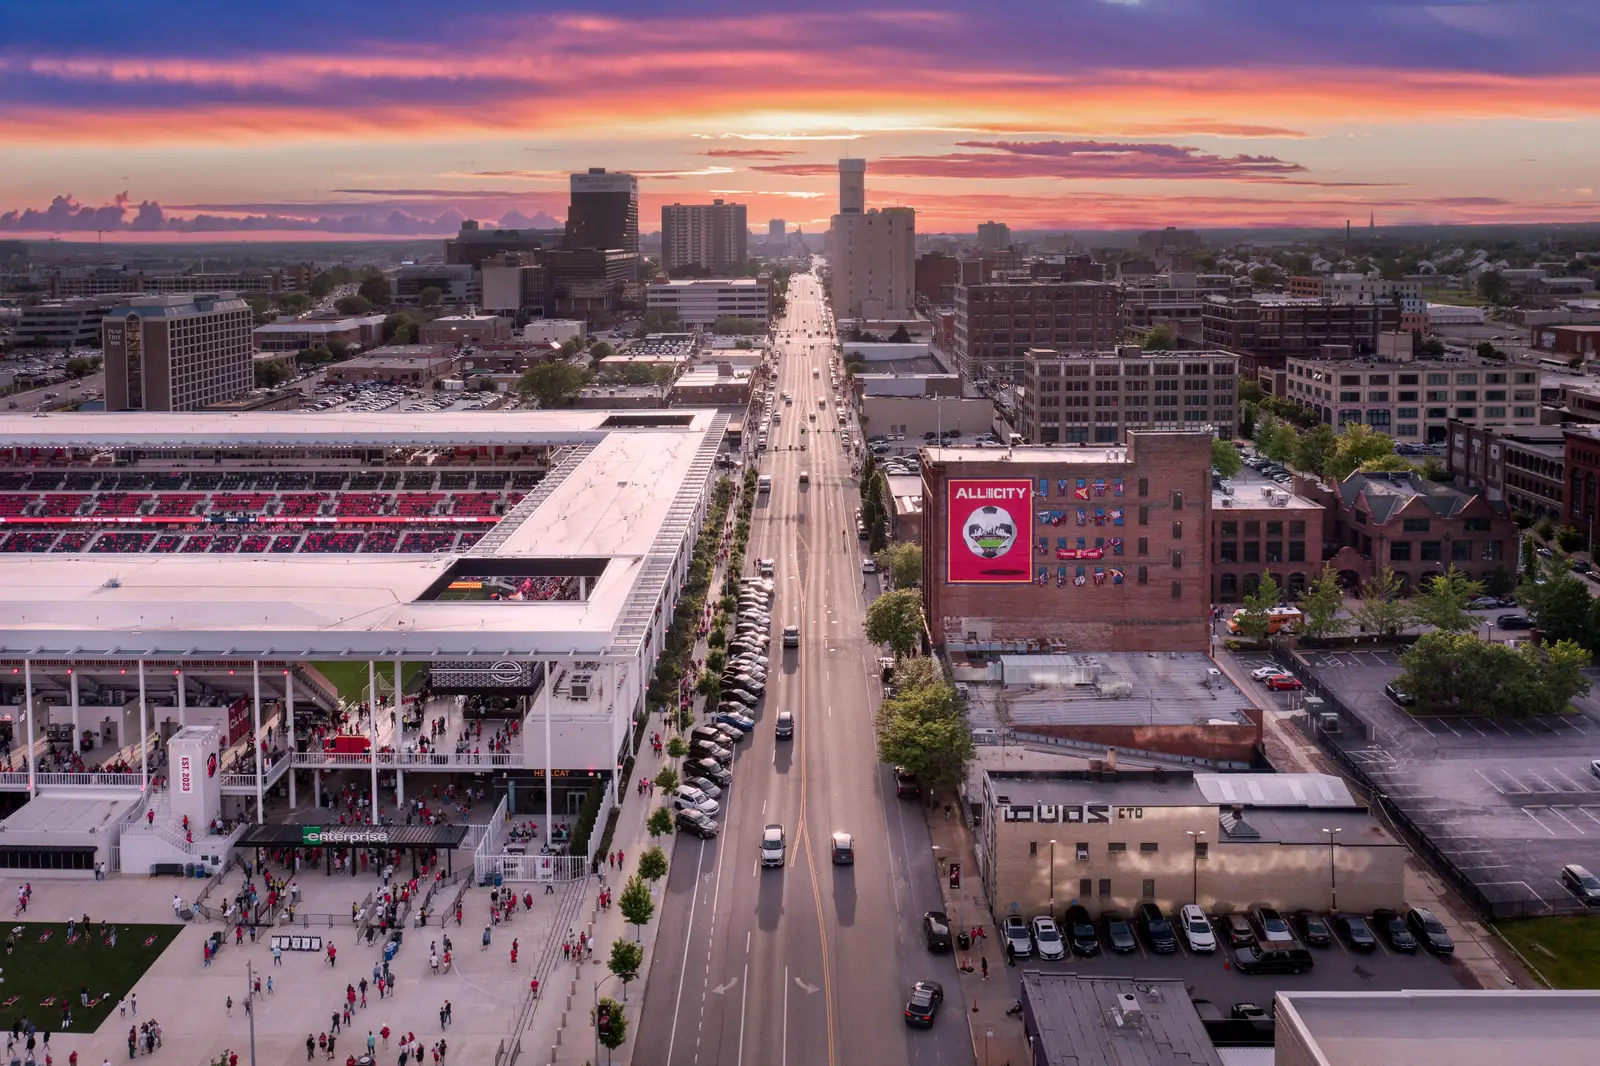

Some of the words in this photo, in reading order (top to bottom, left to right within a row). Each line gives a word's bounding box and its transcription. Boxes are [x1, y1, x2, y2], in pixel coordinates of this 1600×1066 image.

[955, 487, 986, 499] ALL
[993, 487, 1027, 499] CITY
[230, 707, 249, 730] CLUB
[181, 757, 190, 771] EST.
[533, 769, 570, 777] HECAT
[182, 772, 191, 792] 2023
[304, 830, 389, 844] enterprise
